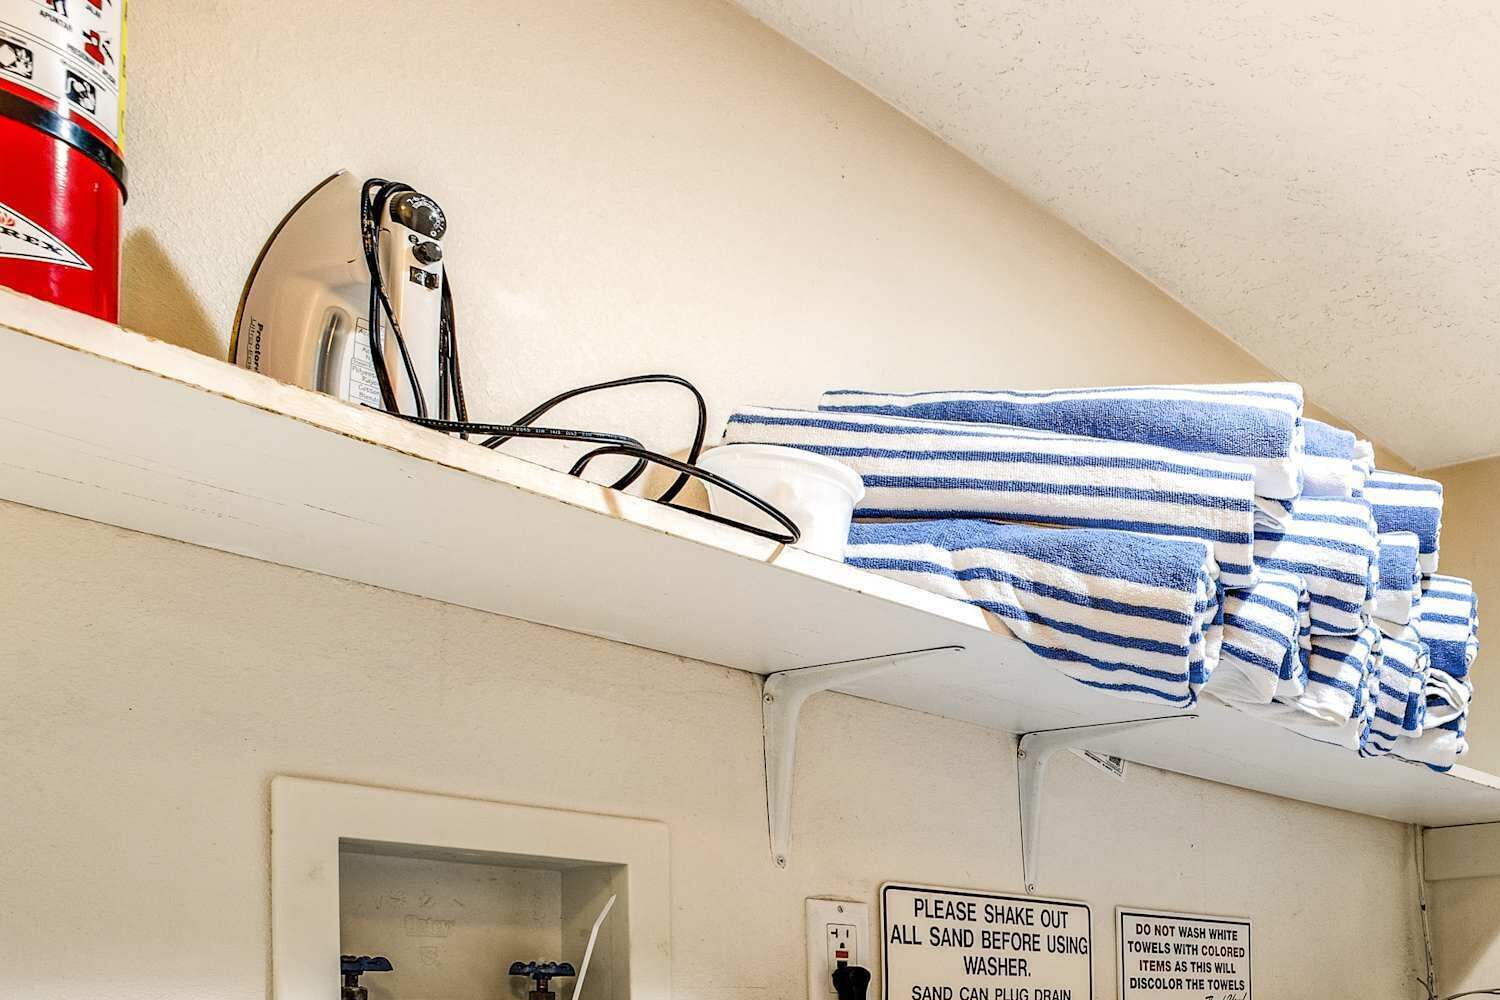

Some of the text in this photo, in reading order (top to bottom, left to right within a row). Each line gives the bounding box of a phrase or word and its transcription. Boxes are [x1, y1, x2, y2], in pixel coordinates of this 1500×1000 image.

[914, 898, 1069, 929] PLEASE SHAKE OUT
[890, 924, 1088, 955] ALL SAND BEFORE USING
[1135, 923, 1238, 941] DO NOT WASH WHITE
[1127, 940, 1245, 958] TOWELS WITH COLORED
[963, 955, 1032, 977] WASHER.
[1139, 959, 1236, 974] ITEMS AS THIS WILL
[911, 985, 953, 1000] SAND
[1129, 977, 1245, 991] DISCOLOR THE TOWELS
